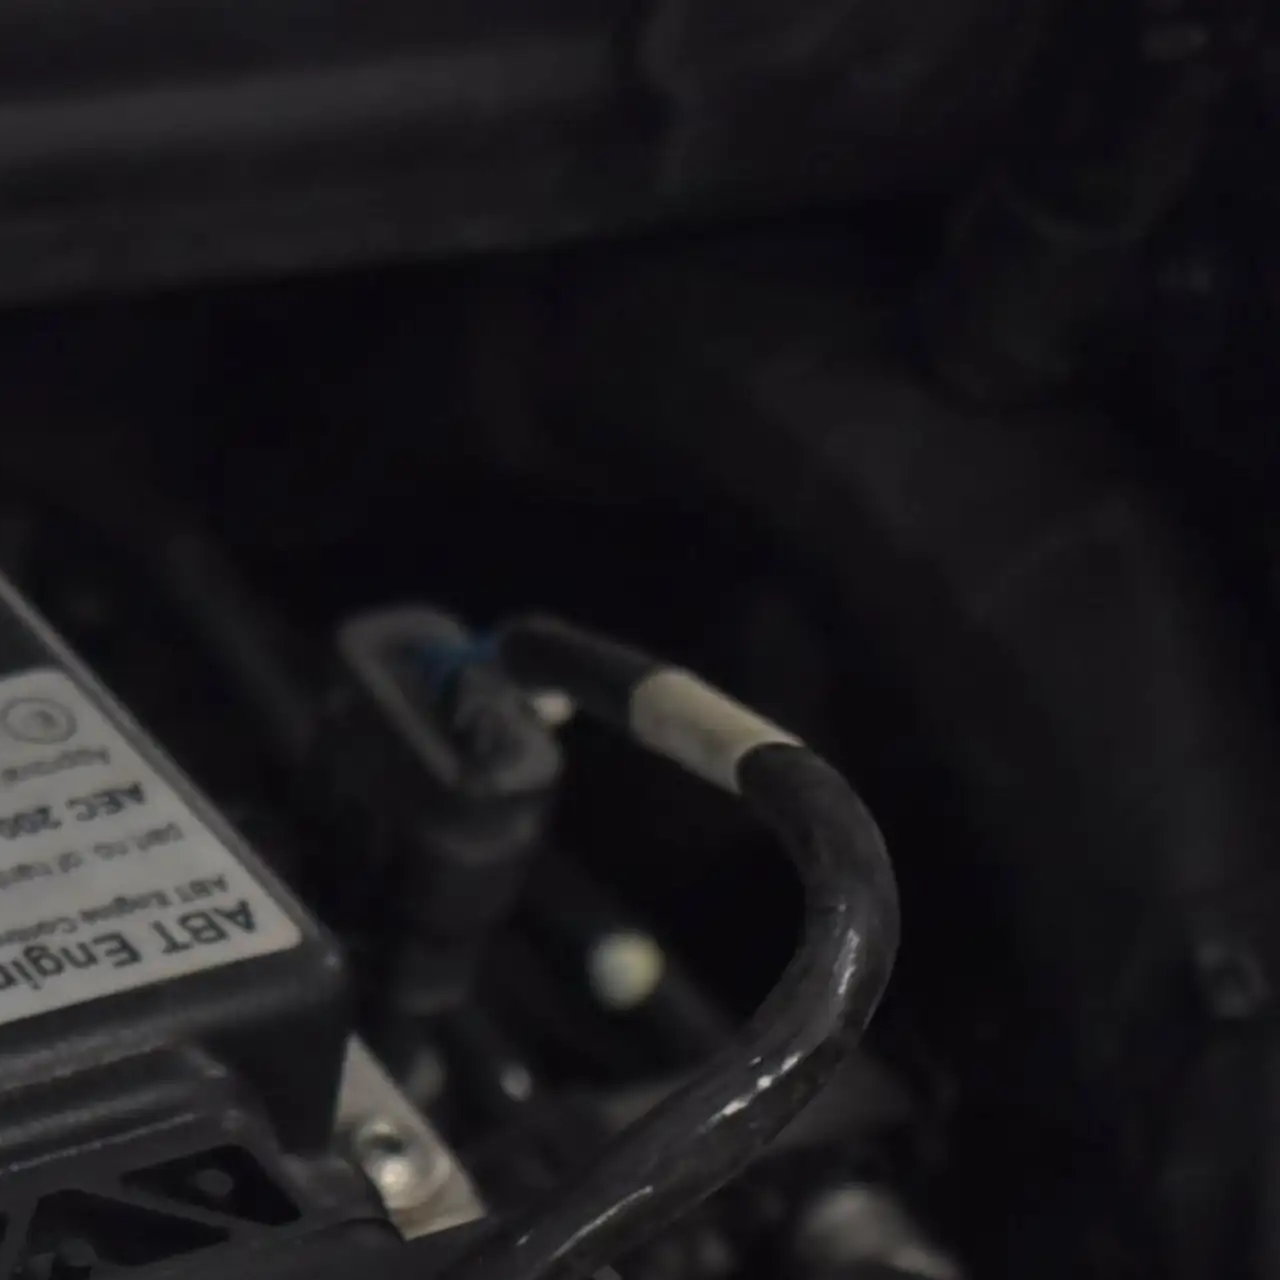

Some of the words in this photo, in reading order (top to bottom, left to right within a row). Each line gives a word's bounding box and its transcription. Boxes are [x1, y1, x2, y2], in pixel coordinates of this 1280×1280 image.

[68, 782, 145, 820] AEC
[175, 875, 228, 903] ABT
[80, 891, 172, 924] Engine
[152, 900, 256, 954] ABT
